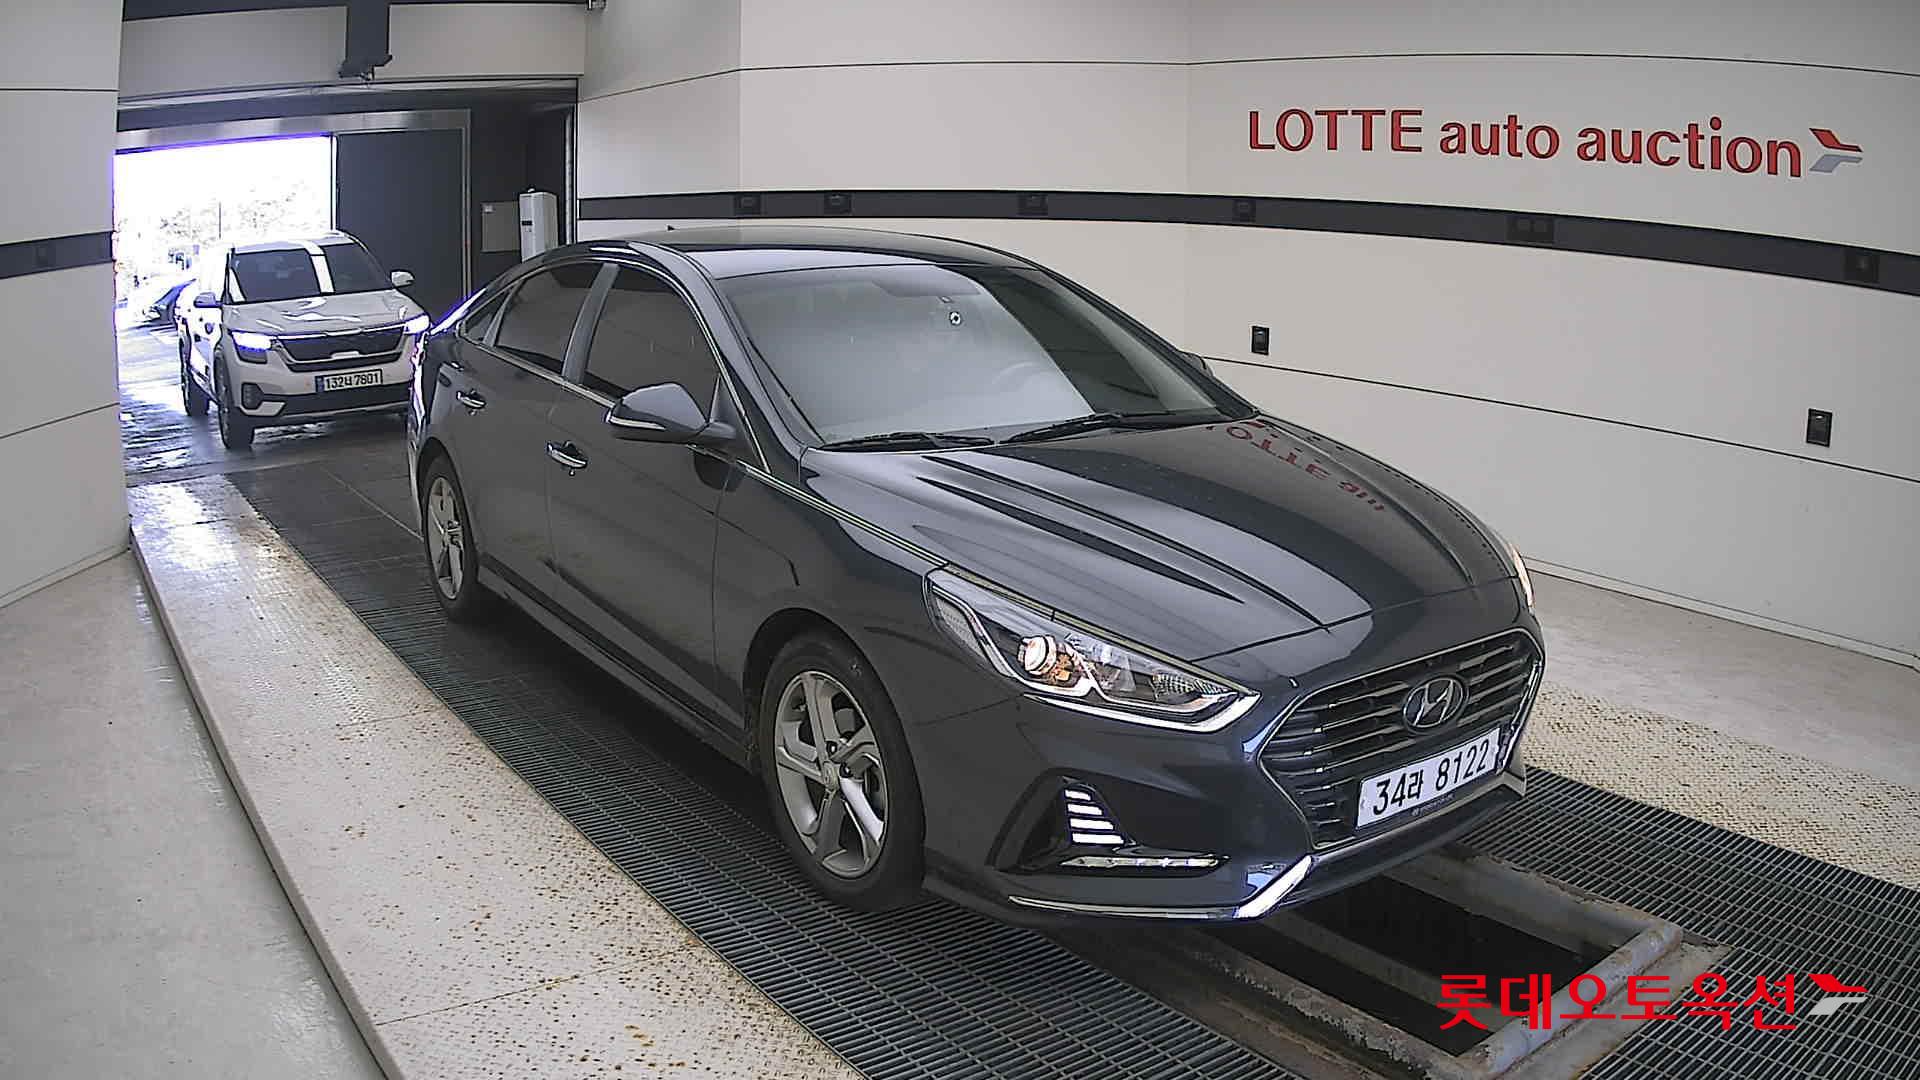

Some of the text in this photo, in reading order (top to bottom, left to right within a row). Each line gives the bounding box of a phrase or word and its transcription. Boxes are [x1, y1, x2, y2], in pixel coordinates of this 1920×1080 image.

[1249, 108, 1802, 178] LOTTE auto auction
[1372, 769, 1424, 815] 34라
[1435, 738, 1489, 791] 8122
